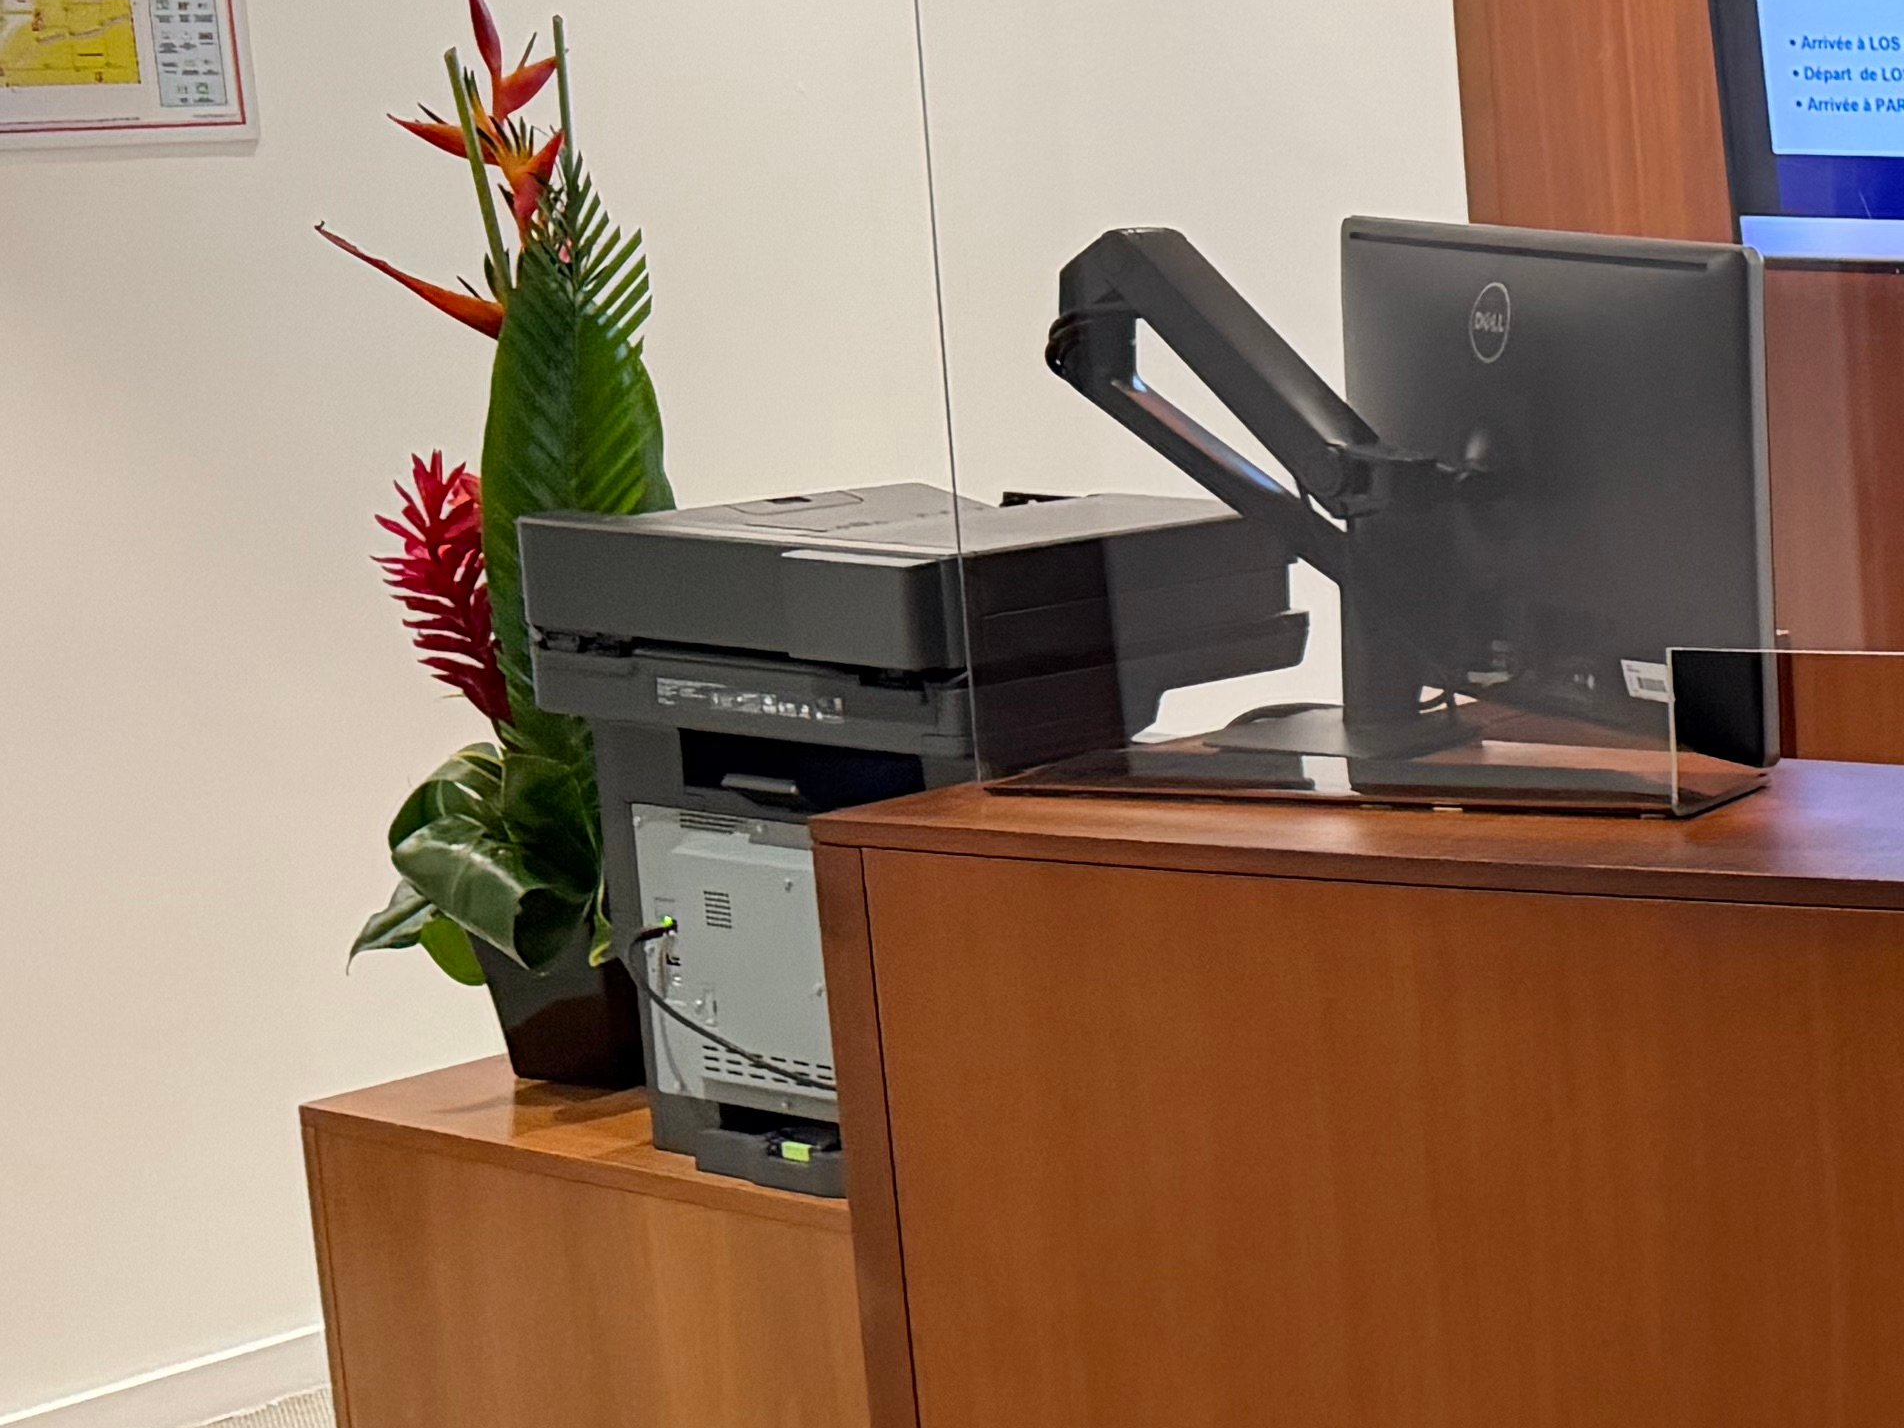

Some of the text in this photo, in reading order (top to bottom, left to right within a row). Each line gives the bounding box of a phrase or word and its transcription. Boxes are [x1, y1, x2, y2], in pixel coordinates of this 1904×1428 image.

[1801, 35, 1852, 52] Arrivée
[1856, 35, 1865, 52] à
[1869, 36, 1900, 52] LOS
[1804, 66, 1852, 85] Départ
[1861, 67, 1878, 82] de
[1808, 96, 1858, 113] Arrivée
[1864, 96, 1871, 112] à
